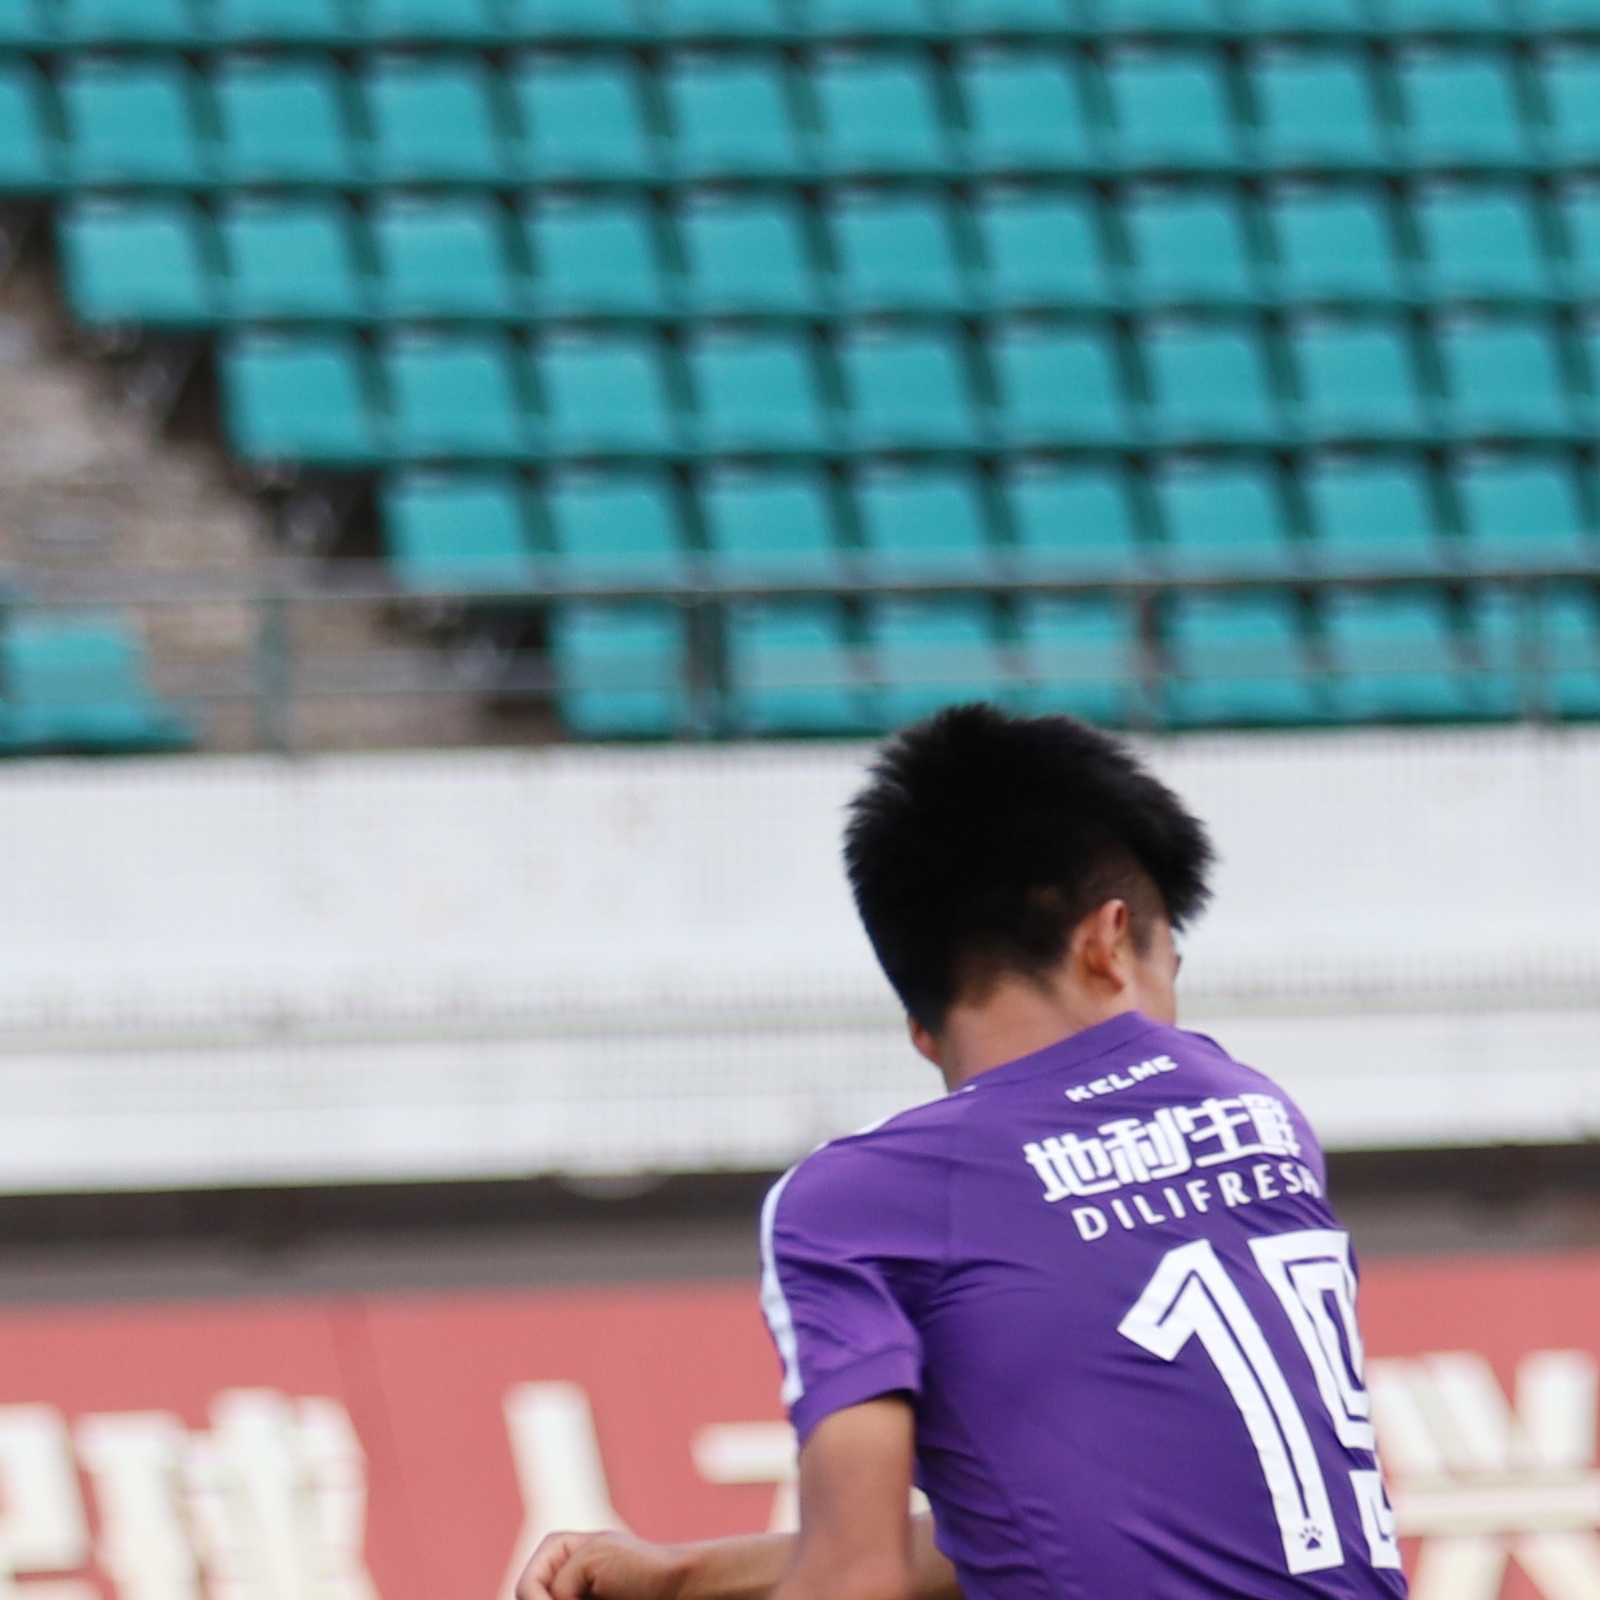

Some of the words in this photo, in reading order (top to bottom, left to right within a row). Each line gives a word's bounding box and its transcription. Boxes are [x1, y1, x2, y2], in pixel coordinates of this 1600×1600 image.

[1064, 1054, 1179, 1102] KELME
[1022, 1093, 1302, 1202] 地利生鲜
[1070, 1162, 1323, 1242] DILIFRESH
[1116, 1228, 1402, 1575] 19
